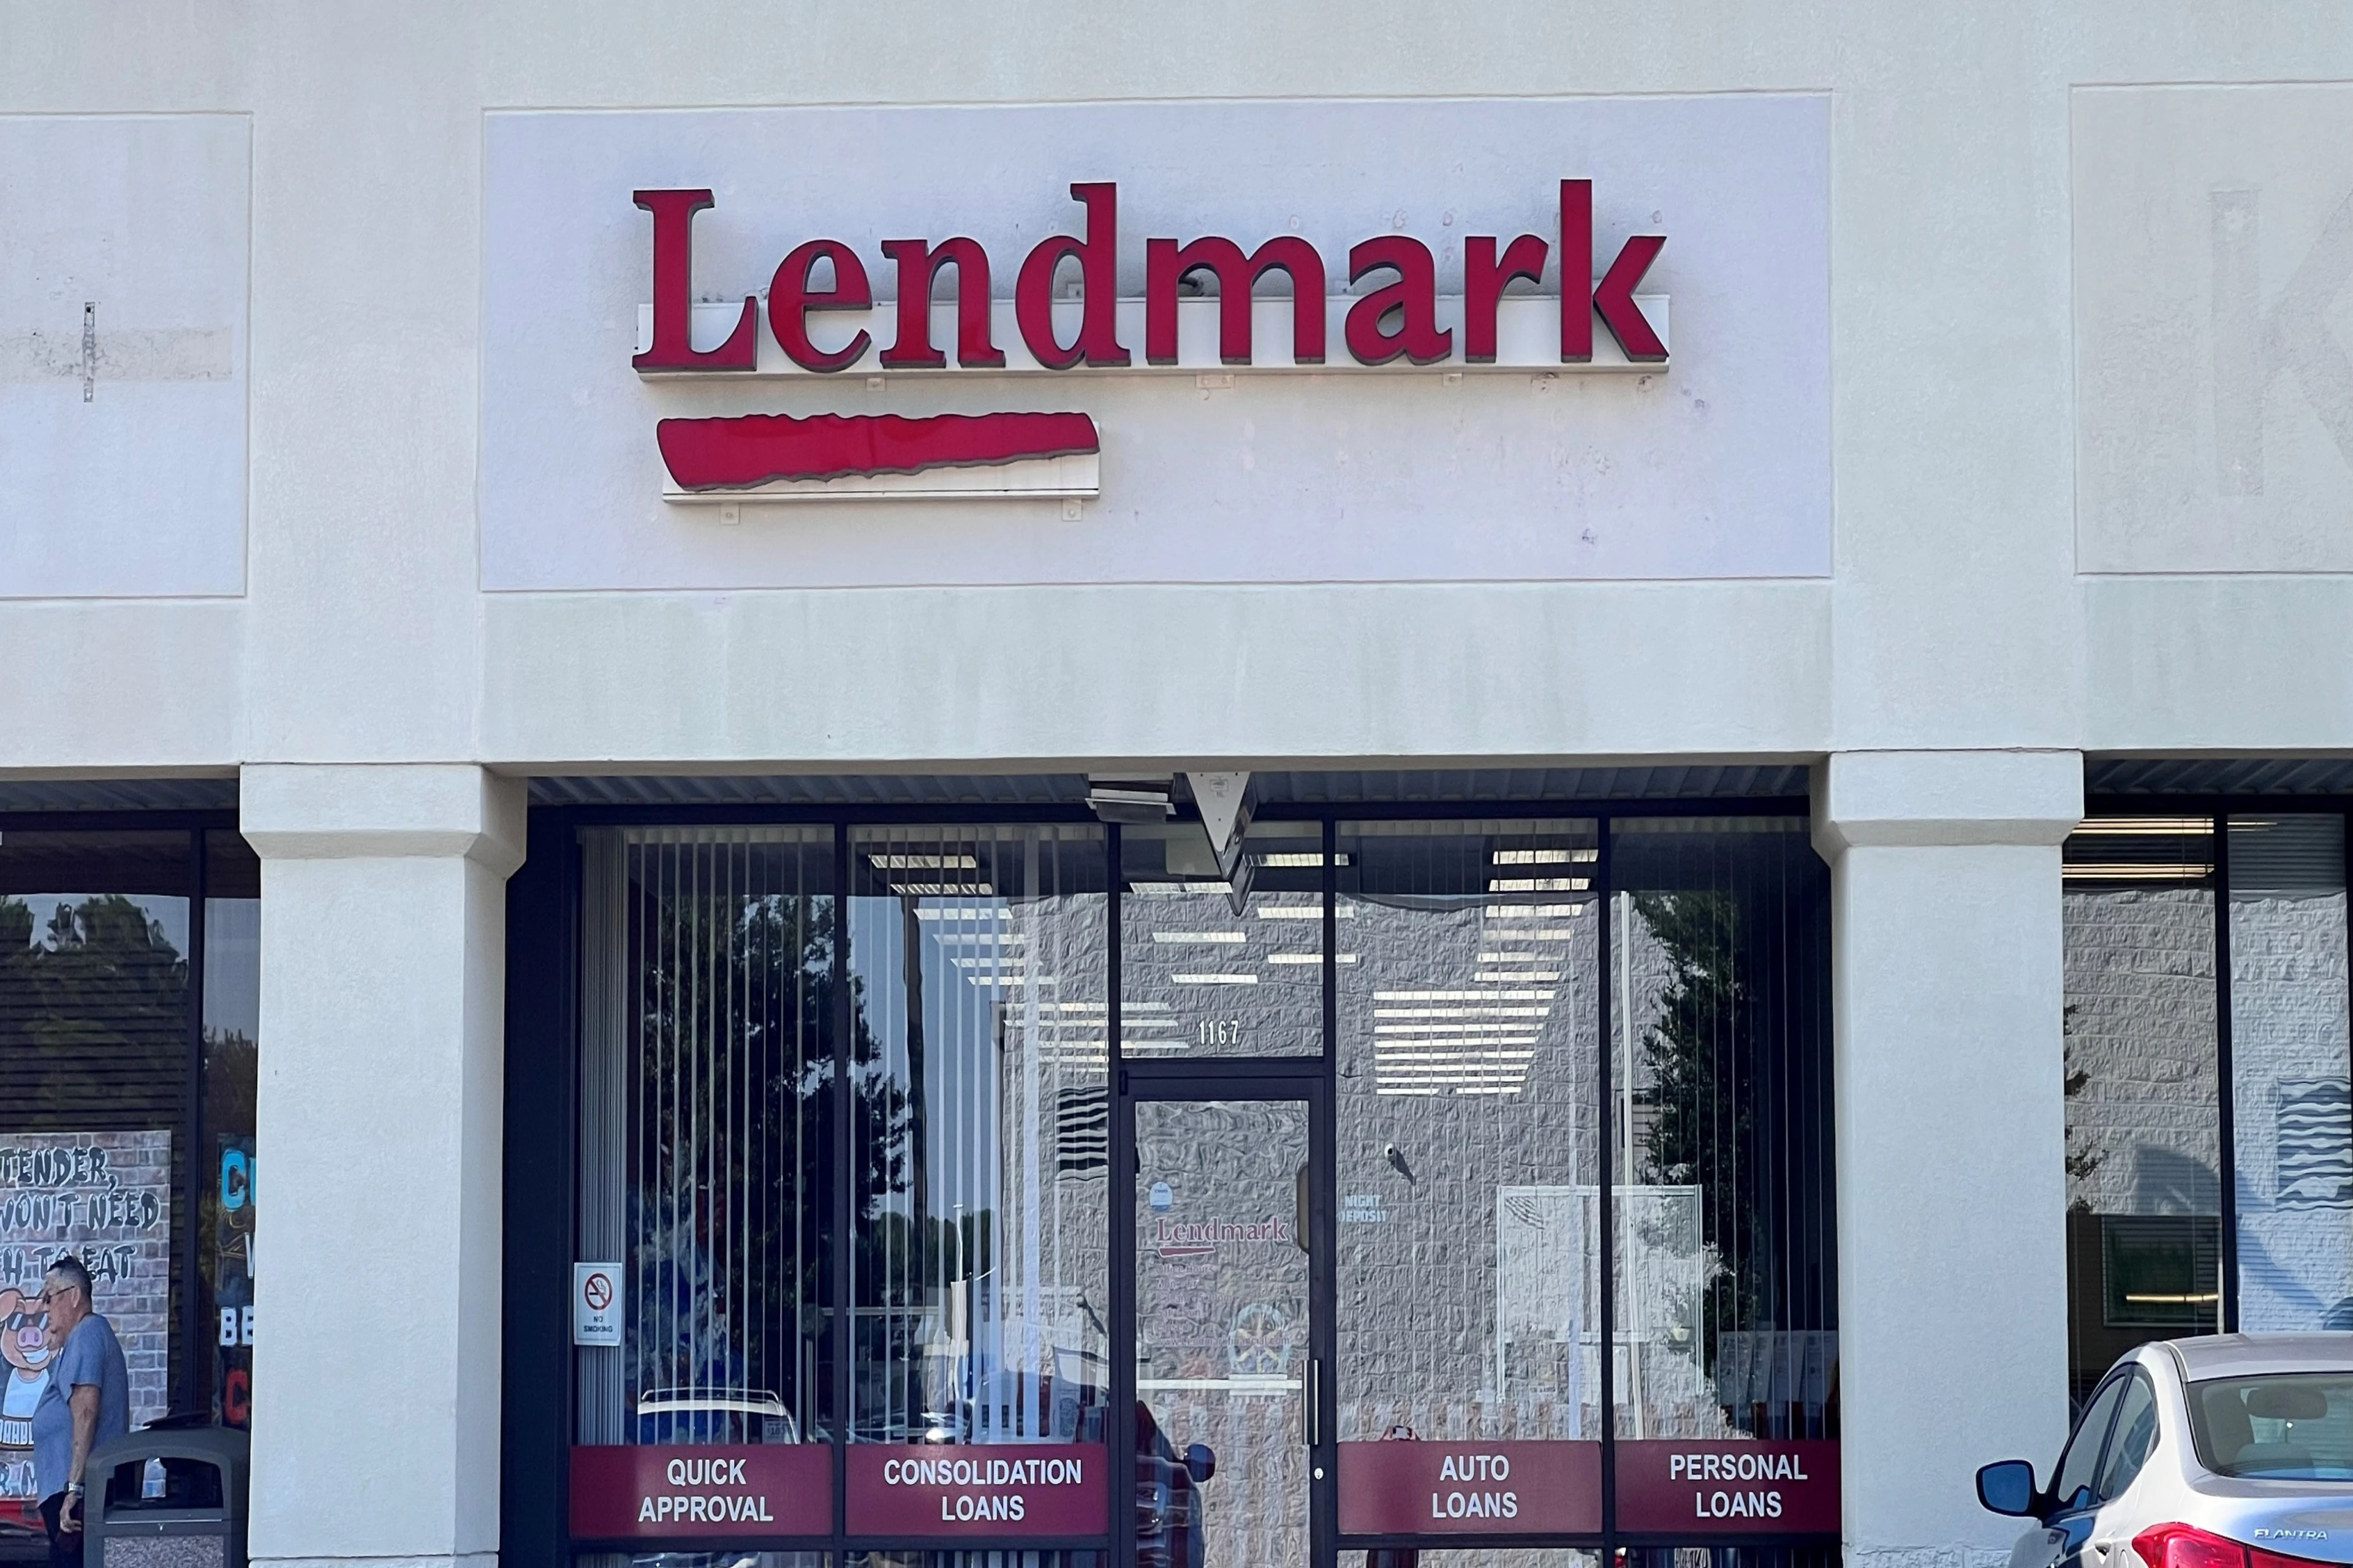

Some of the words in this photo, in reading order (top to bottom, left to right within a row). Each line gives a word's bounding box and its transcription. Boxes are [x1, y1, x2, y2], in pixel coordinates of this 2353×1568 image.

[632, 179, 1670, 373] Lendmark
[1199, 1020, 1238, 1045] 1167
[0, 1147, 118, 1191] TENDER,
[88, 1191, 161, 1231] NEED
[1344, 1195, 1381, 1207] NIGHT
[1156, 1216, 1288, 1241] Lendmark
[1338, 1210, 1387, 1222] DEPOSIT
[667, 1459, 746, 1487] QUICK
[884, 1460, 1082, 1485] CONSOLIDATION
[1439, 1455, 1509, 1482] AUTO
[1670, 1455, 1808, 1480] PERSONAL
[638, 1496, 773, 1523] APPROVAL
[942, 1496, 1025, 1521] LOANS
[1432, 1492, 1518, 1518] LOANS
[1696, 1491, 1782, 1518] LOANS
[2254, 1528, 2328, 1541] ELANTRA
